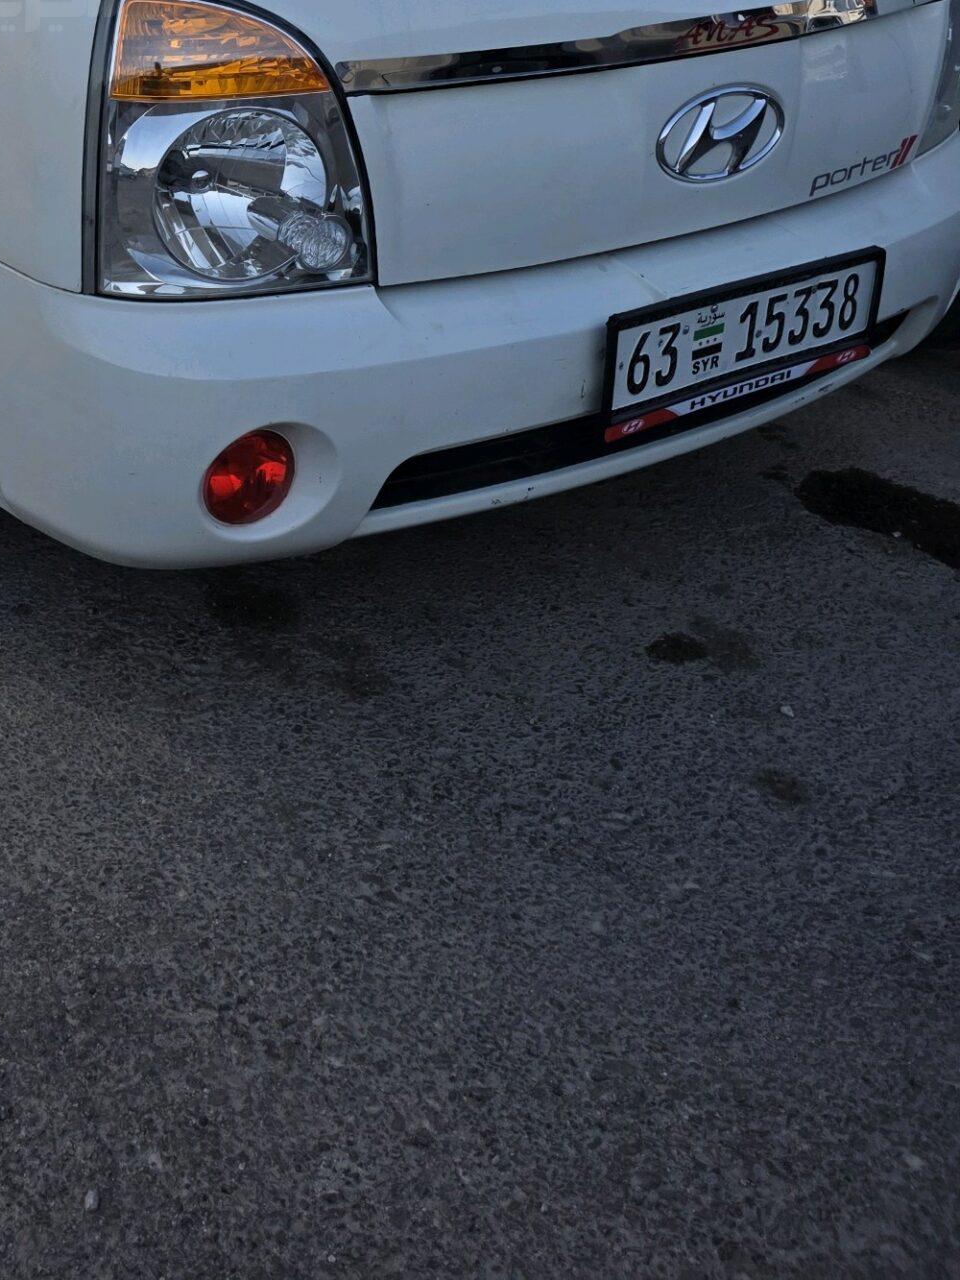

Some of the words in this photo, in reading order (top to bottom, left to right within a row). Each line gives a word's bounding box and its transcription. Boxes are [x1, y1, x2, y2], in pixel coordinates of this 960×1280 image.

[626, 322, 682, 396] 63
[734, 273, 860, 363] 15338
[691, 355, 720, 375] SYR
[689, 369, 792, 410] HYUNDAI
